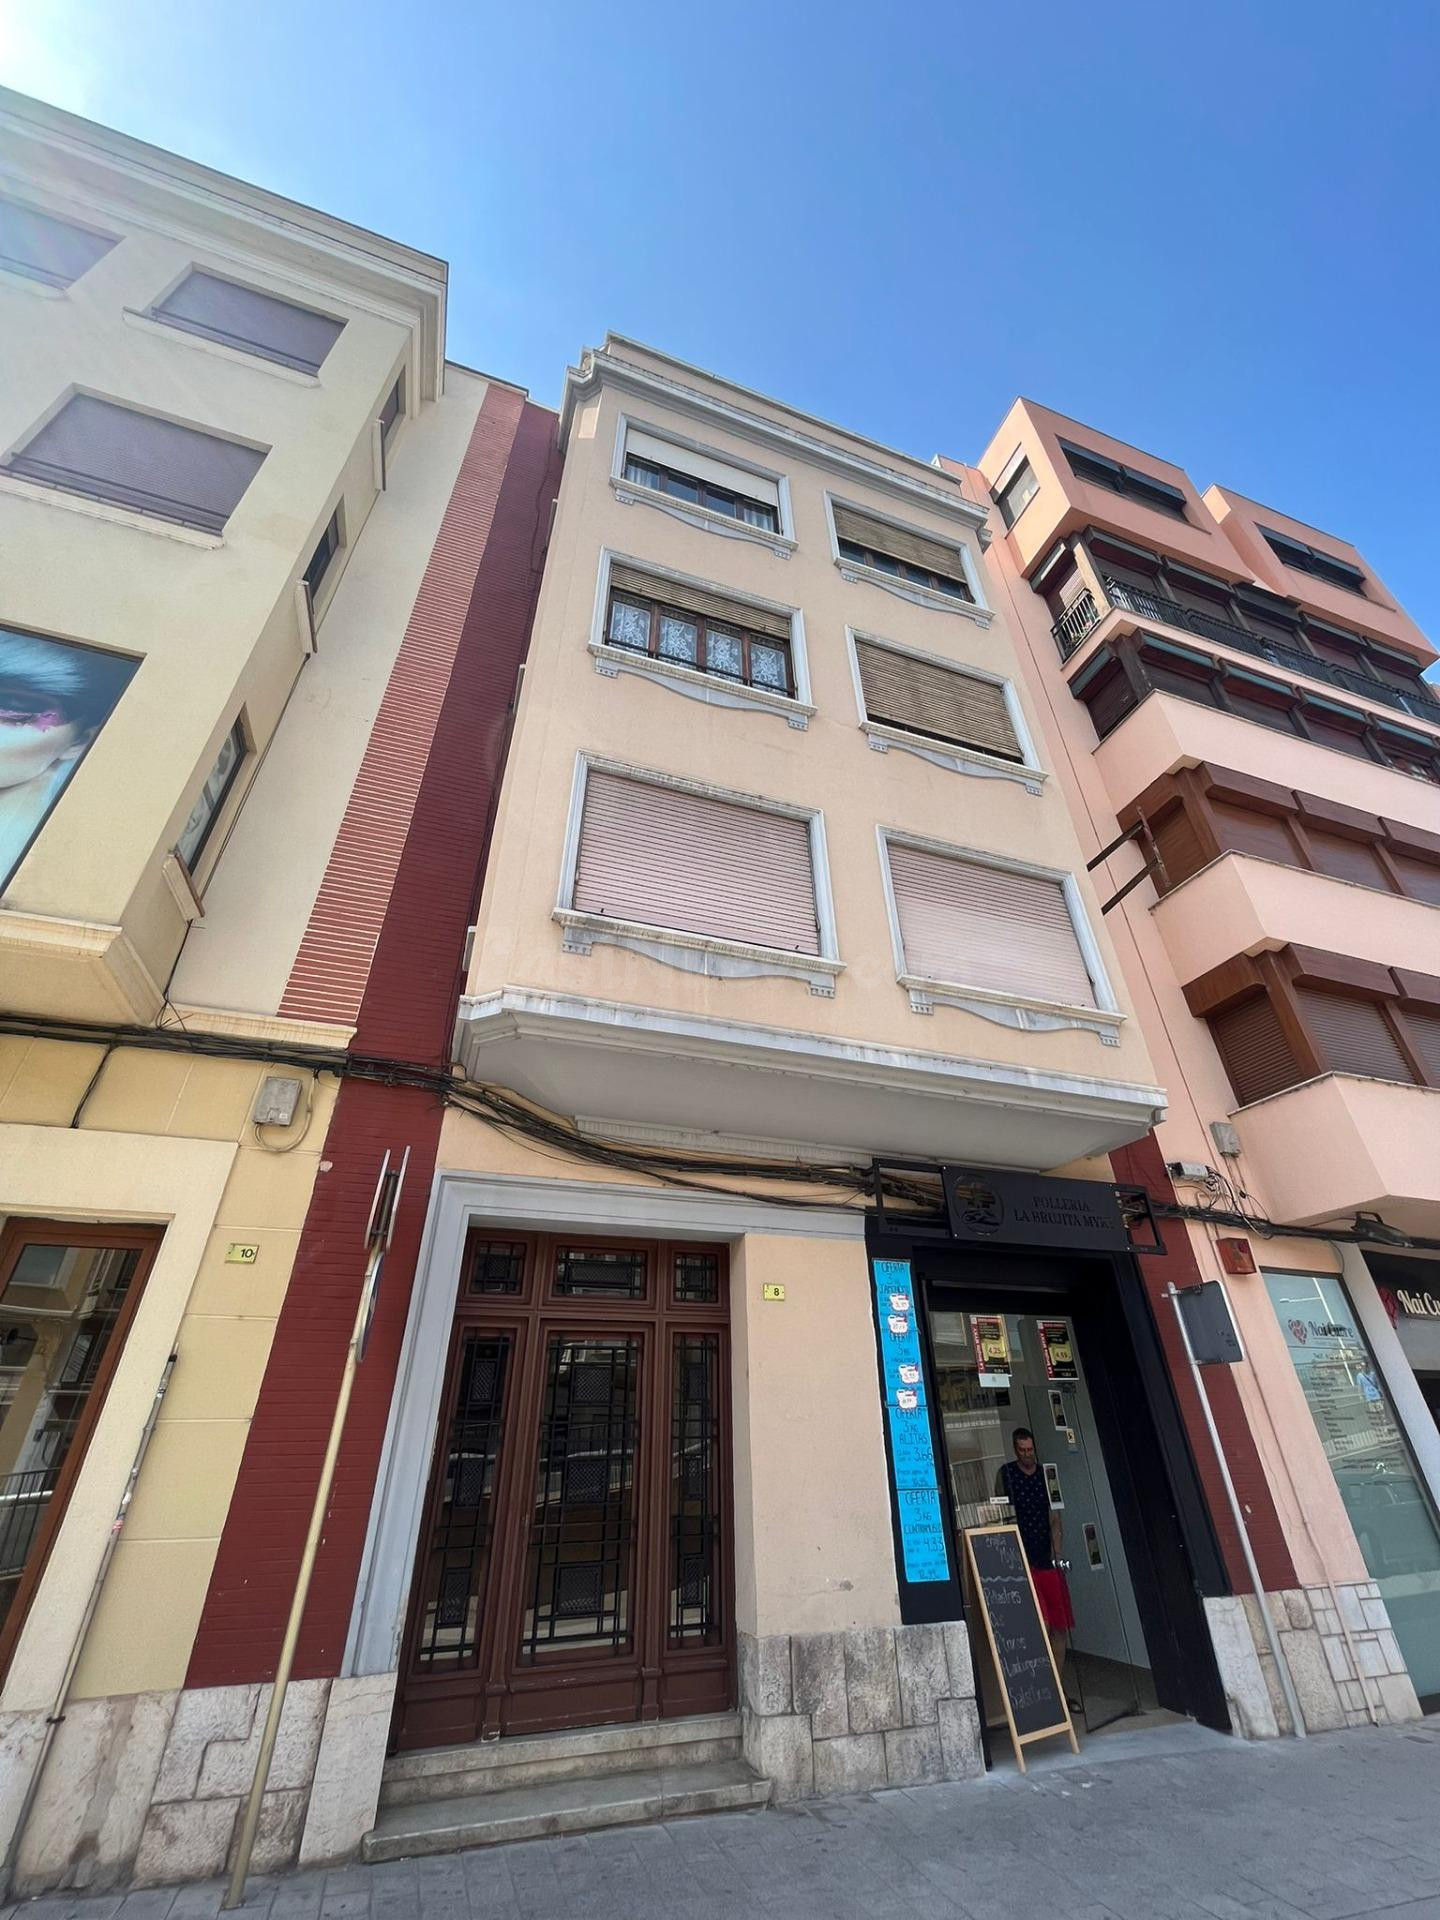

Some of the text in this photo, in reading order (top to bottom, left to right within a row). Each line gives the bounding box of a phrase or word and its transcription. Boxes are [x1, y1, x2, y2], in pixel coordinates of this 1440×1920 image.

[1013, 1209, 1031, 1223] LA
[1031, 1211, 1082, 1227] BRUJITA
[241, 1248, 254, 1258] 10
[773, 1287, 780, 1296] 8
[1397, 1289, 1427, 1315] Nai
[895, 1408, 922, 1420] OFERTA
[903, 1420, 910, 1432] 3
[899, 1432, 928, 1445] ALITAS
[904, 1490, 936, 1505] OFERTA
[914, 1508, 922, 1521] 3
